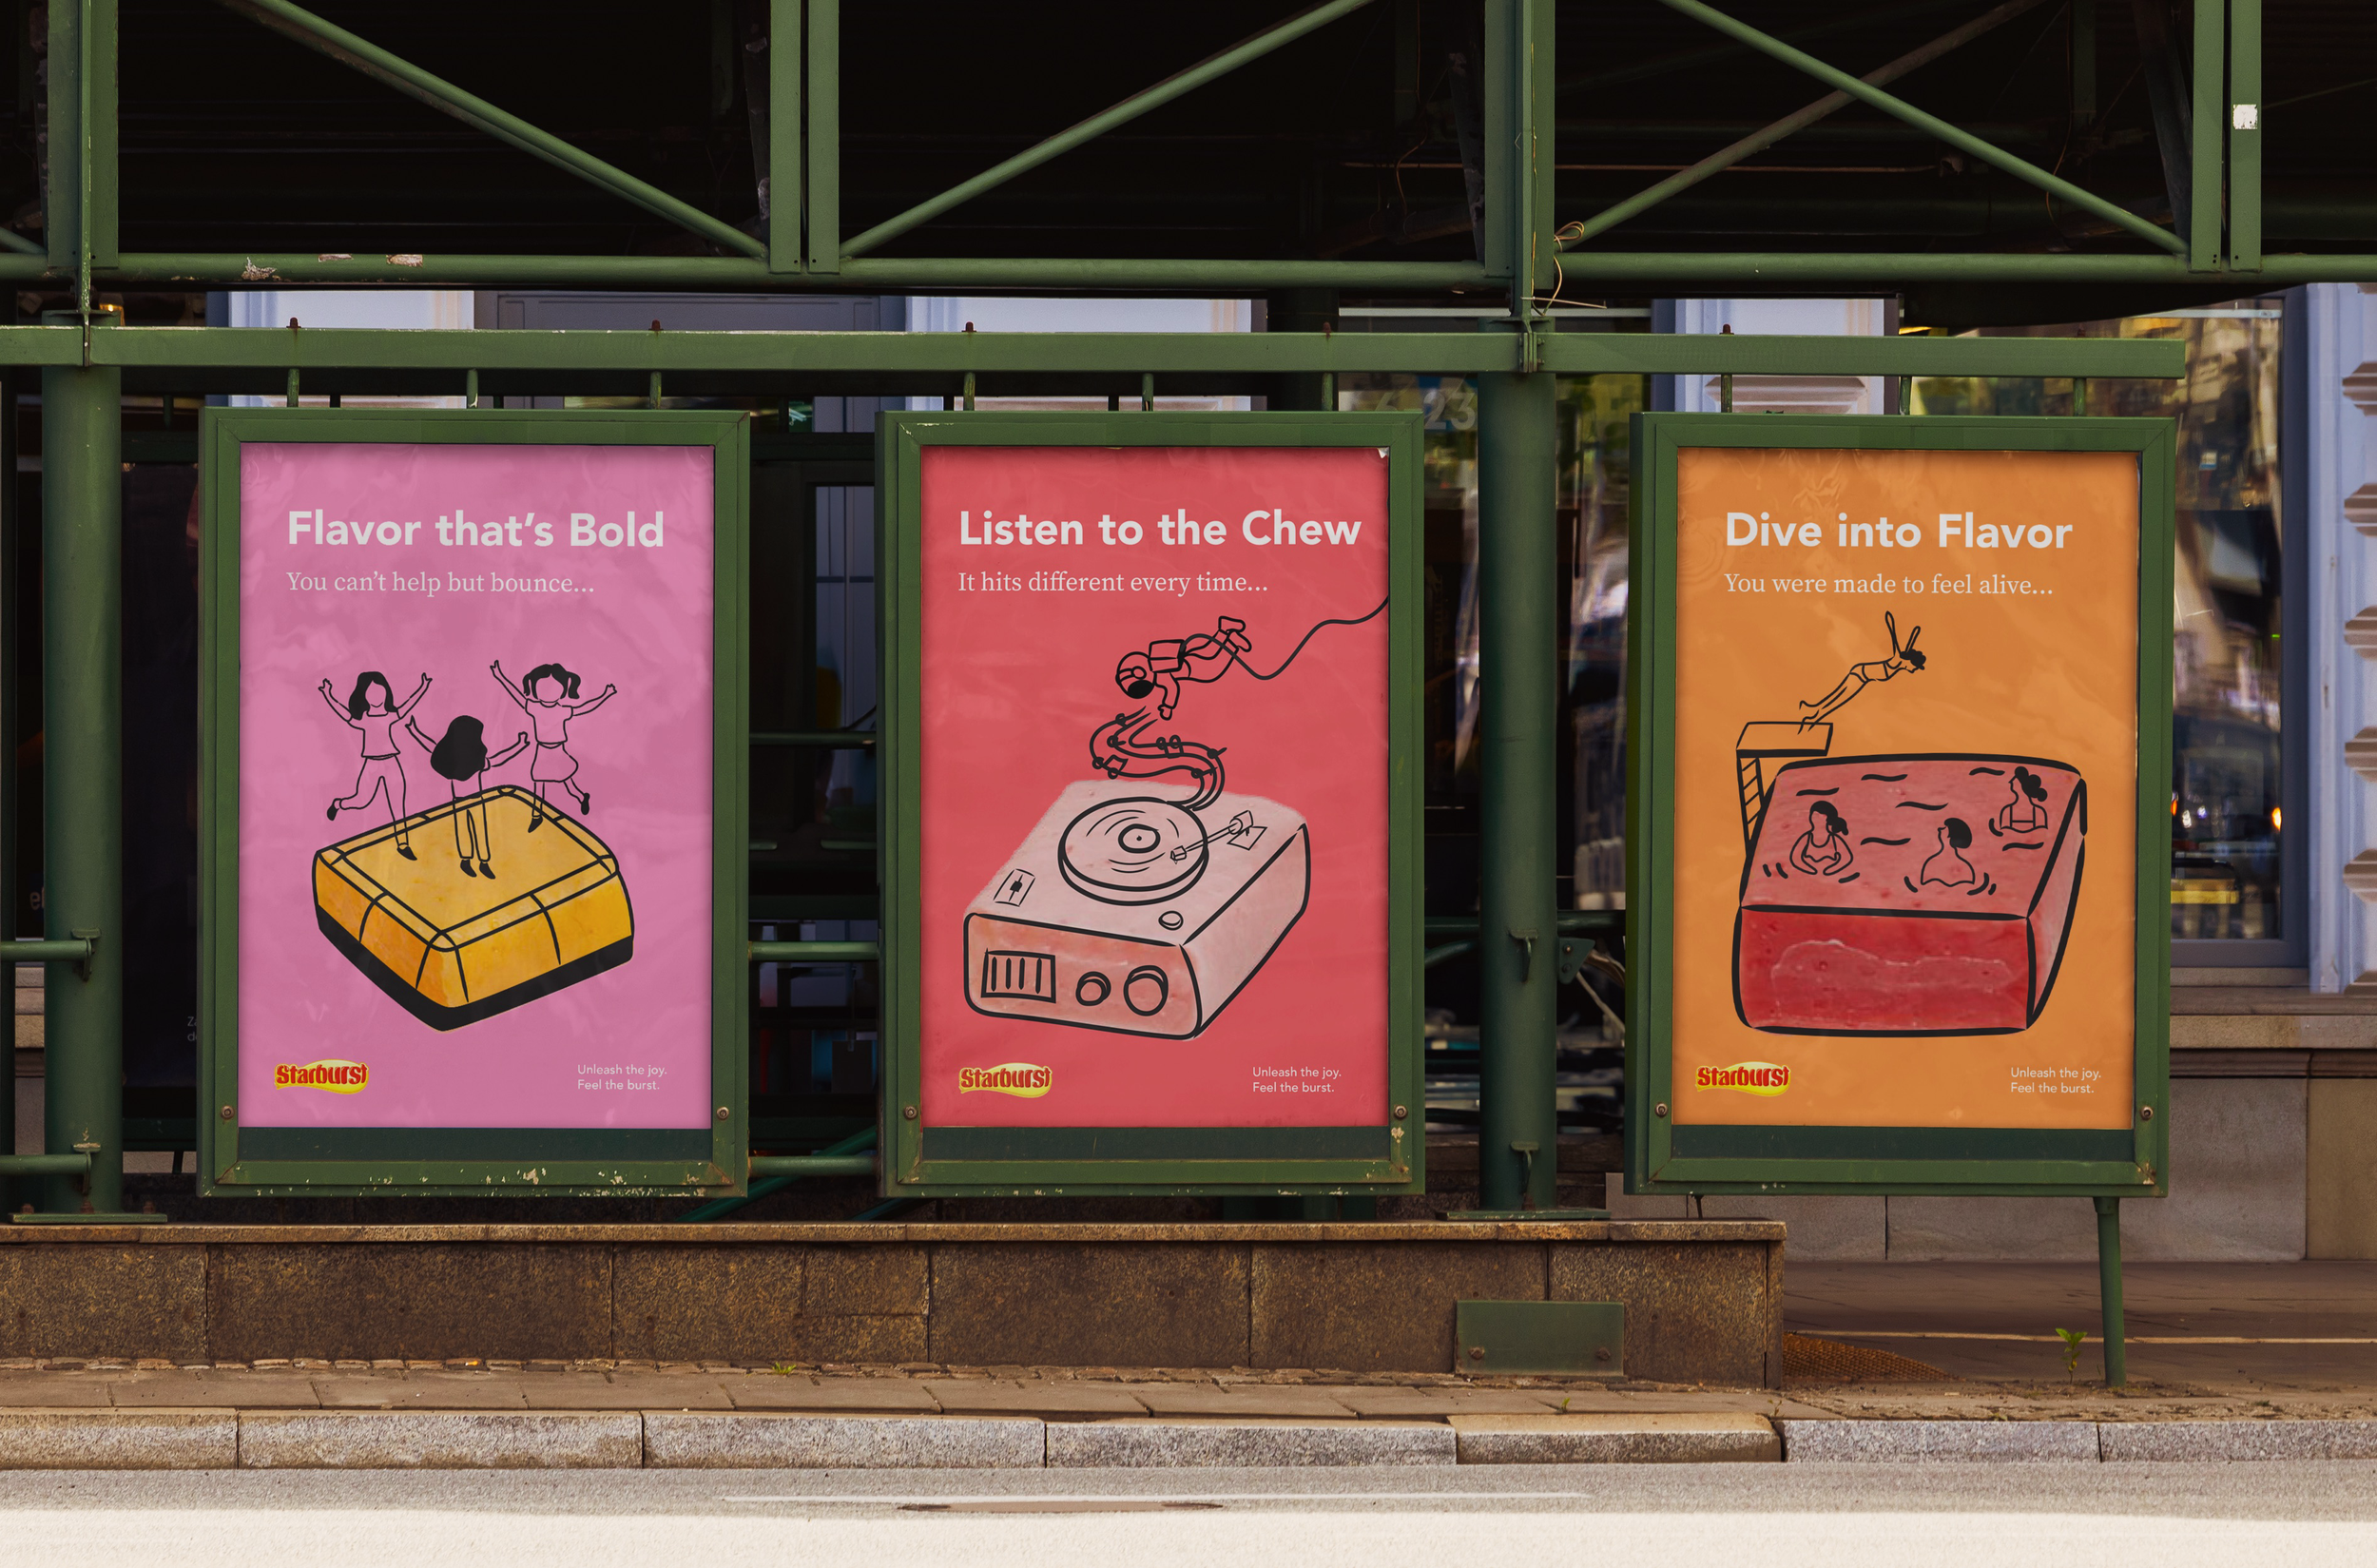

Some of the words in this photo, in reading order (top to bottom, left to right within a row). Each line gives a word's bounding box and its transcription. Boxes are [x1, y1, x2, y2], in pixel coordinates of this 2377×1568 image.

[289, 509, 422, 546] Flavor
[435, 509, 554, 547] that’s
[570, 511, 664, 548] Bold
[960, 510, 1084, 546] Listen
[1097, 513, 1144, 546] to
[1157, 508, 1227, 546] the
[1242, 508, 1362, 546] Chew
[1726, 511, 1823, 548] Dive
[1838, 512, 1922, 549] into
[1939, 511, 2074, 550] Flavor
[286, 571, 328, 591] You
[334, 571, 387, 592] can’t
[392, 571, 441, 598] help
[447, 571, 485, 592] but
[490, 571, 594, 593] bounce...
[957, 572, 976, 591] It
[980, 571, 1022, 591] hits
[1028, 570, 1125, 591] different
[1130, 576, 1191, 598] every
[1196, 571, 1268, 591] time...
[1723, 572, 1767, 593] You
[1771, 578, 1827, 593] were
[1833, 572, 1897, 593] made
[1902, 575, 1925, 594] to
[1931, 572, 1973, 594] feel
[1979, 573, 2053, 595] alive...
[275, 1063, 368, 1086] Starburst
[577, 1063, 623, 1075] Unleash
[625, 1063, 645, 1075] the
[647, 1064, 667, 1078] joy.
[959, 1066, 1052, 1089] Starburst
[1252, 1065, 1298, 1077] Unleash
[1300, 1066, 1320, 1077] the
[1321, 1066, 1342, 1080] joy.
[1696, 1065, 1790, 1088] Starburst
[2010, 1066, 2057, 1078] Unleash
[2058, 1066, 2079, 1078] the
[2080, 1067, 2102, 1081] joy.
[577, 1078, 602, 1091] Feel
[605, 1078, 624, 1091] the
[627, 1078, 660, 1091] burst.
[1252, 1081, 1277, 1094] Feel
[1279, 1081, 1299, 1094] the
[1302, 1081, 1335, 1094] burst.
[2010, 1081, 2036, 1094] Feel
[2038, 1081, 2058, 1094] the
[2060, 1081, 2095, 1094] burst.
